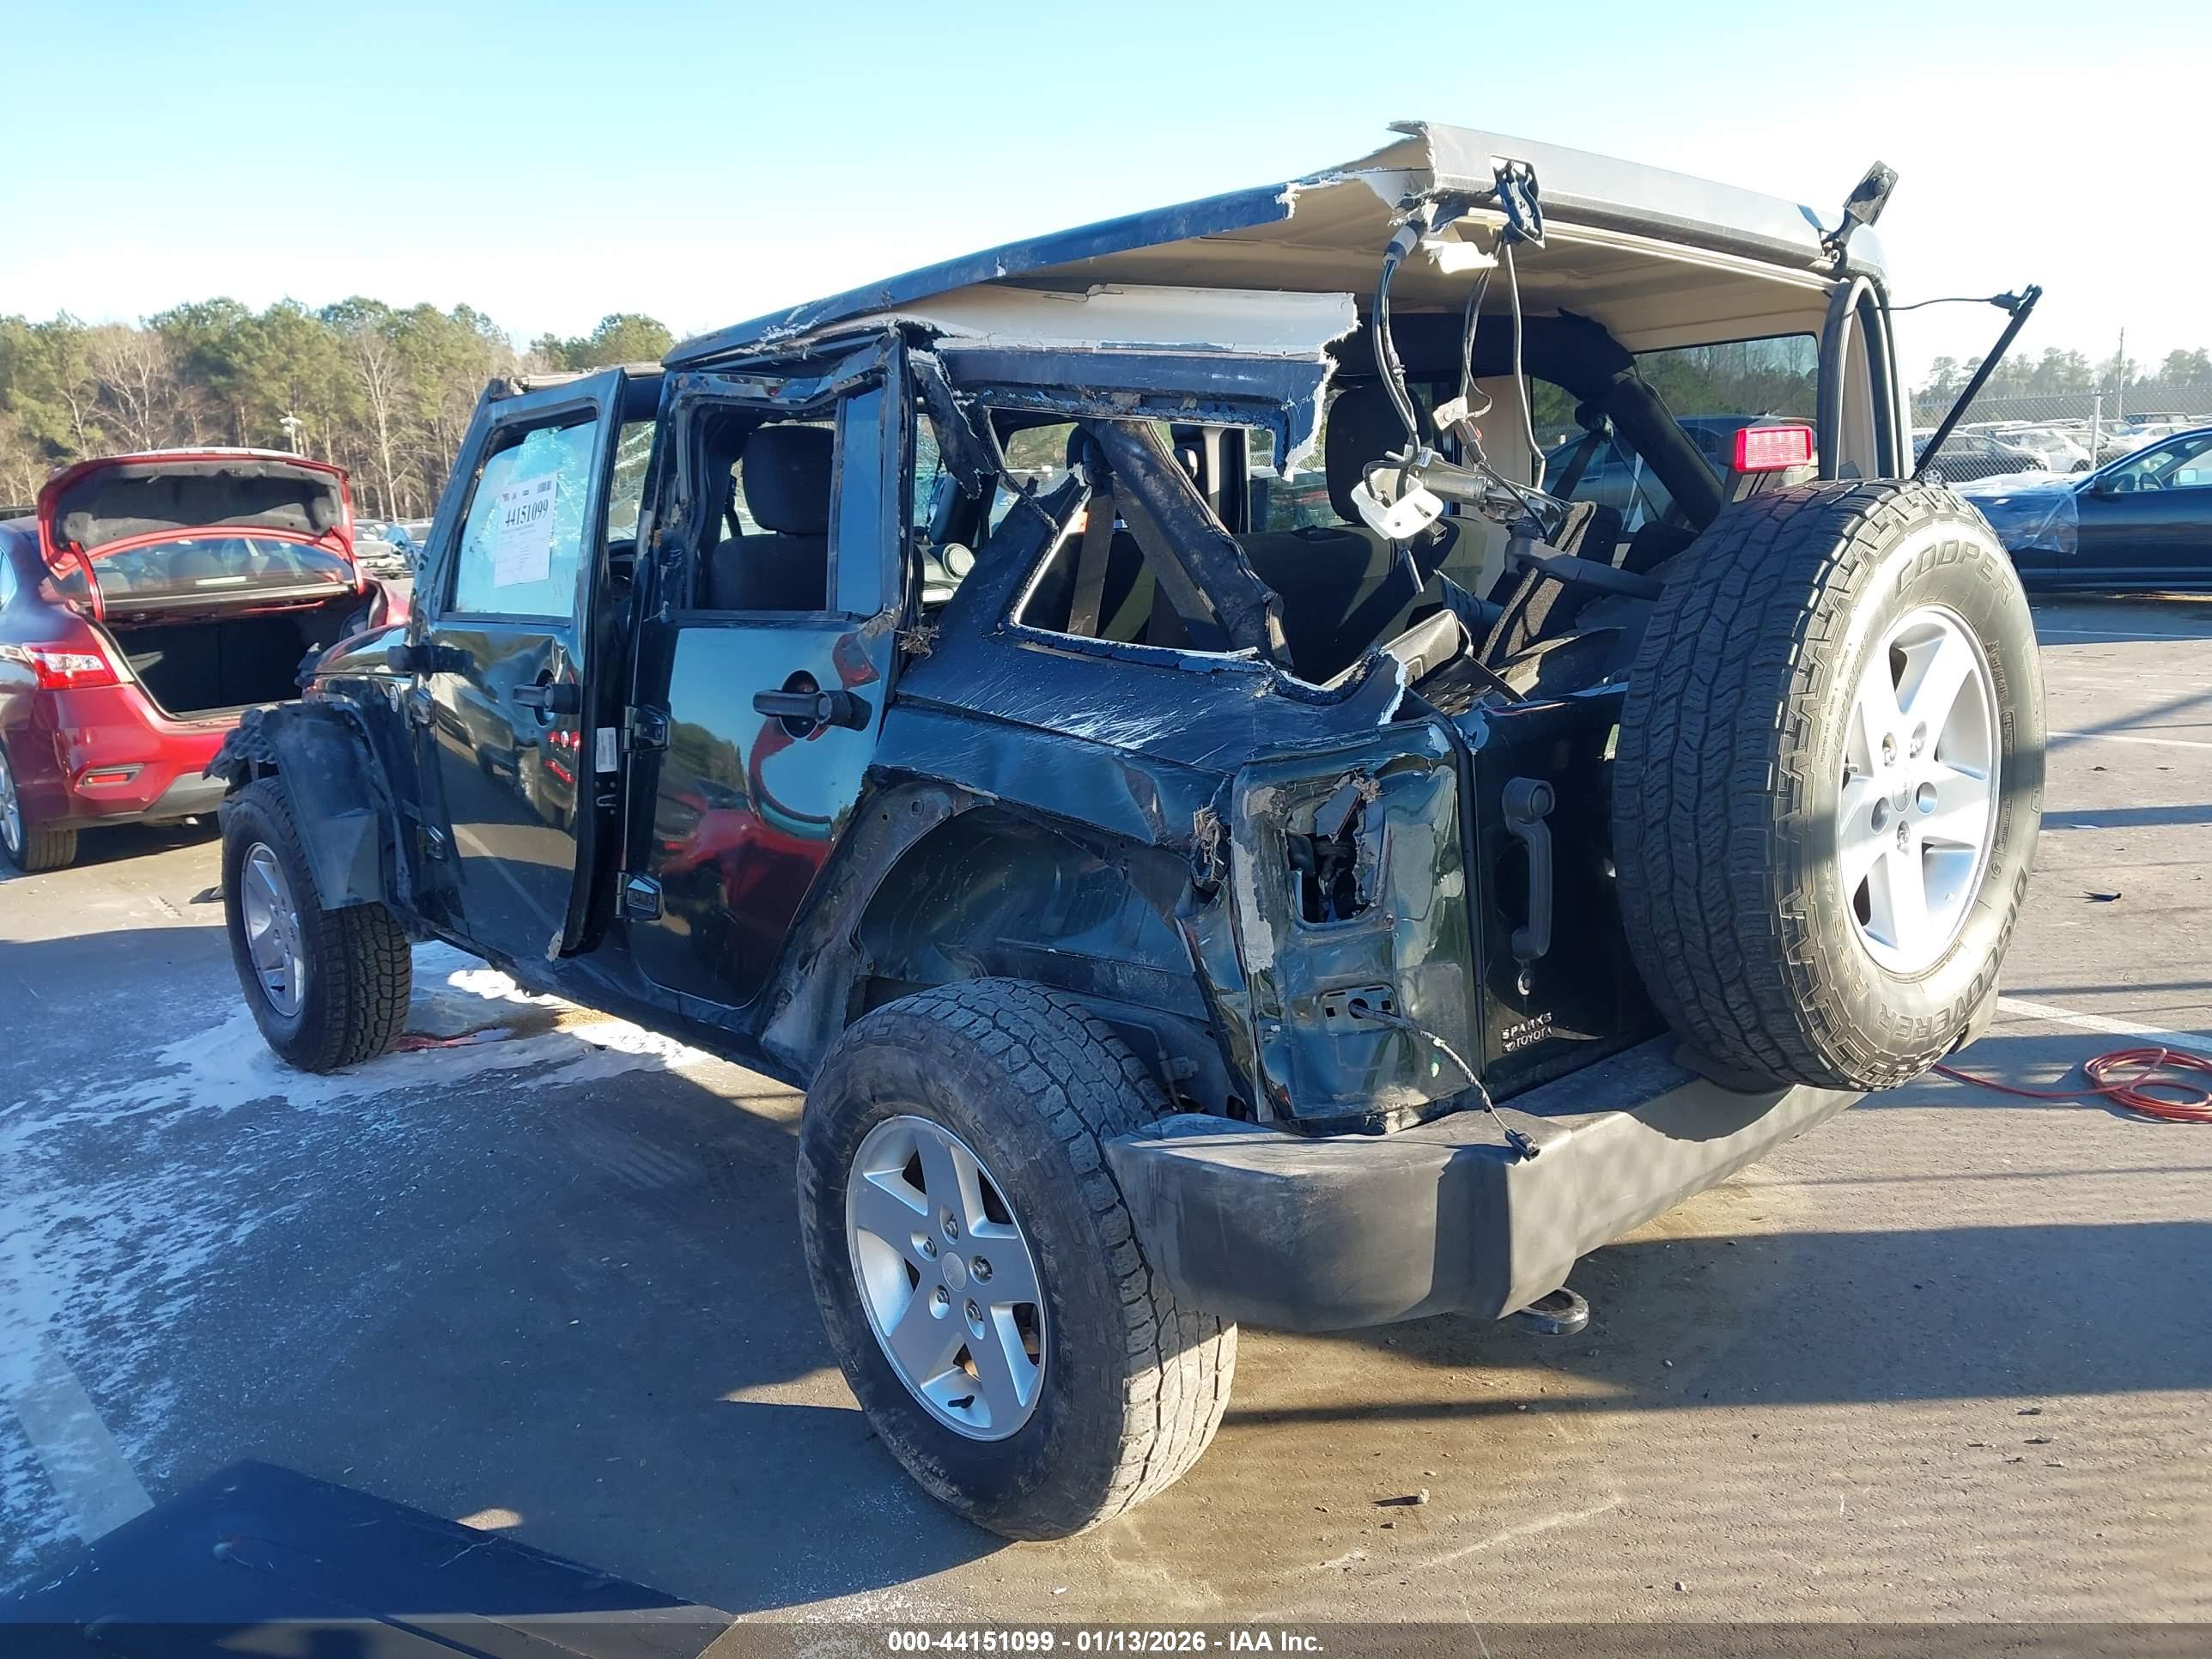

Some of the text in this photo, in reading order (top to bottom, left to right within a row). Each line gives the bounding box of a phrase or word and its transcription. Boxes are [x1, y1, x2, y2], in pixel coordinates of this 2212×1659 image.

[505, 498, 549, 527] 44151099
[1894, 539, 2014, 605] COOPER
[1875, 865, 2028, 1041] DISCOVERER
[1516, 1025, 1553, 1048] TOYOTA
